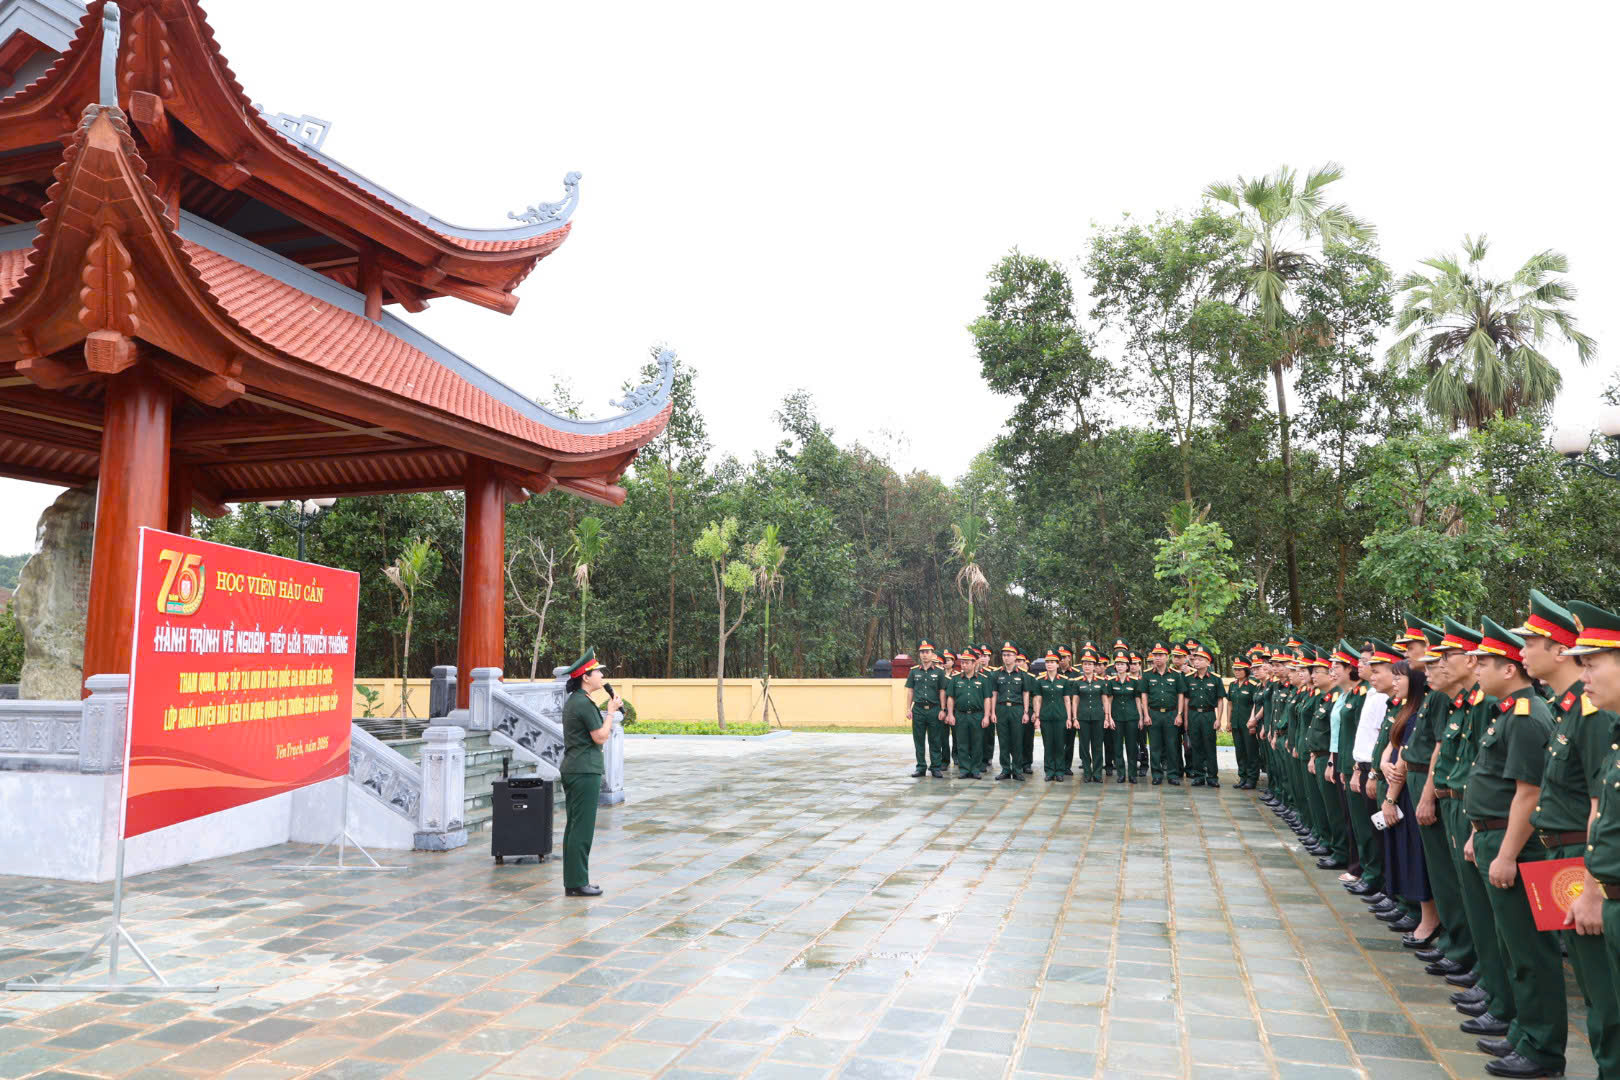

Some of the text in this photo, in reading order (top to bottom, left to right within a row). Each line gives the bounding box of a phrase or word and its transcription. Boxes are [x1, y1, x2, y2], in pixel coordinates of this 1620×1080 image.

[216, 571, 324, 604] HỌC VIỆN HẬU CẦN
[153, 620, 188, 652] HÀNH
[190, 623, 220, 655] TRÌNH
[222, 620, 235, 653] VỀ
[236, 622, 266, 653] NGUỒN
[269, 625, 287, 653] TIẾP
[287, 627, 301, 653] LỬA
[303, 628, 327, 656] TRUYỀN
[328, 629, 348, 654] THỐNG
[179, 672, 198, 693] THAM
[217, 671, 229, 695] HỌC
[230, 667, 241, 695] TẬP
[267, 666, 279, 688] TÍCH
[279, 664, 291, 689] QUỐC
[163, 705, 178, 731] LỚP
[178, 700, 197, 729] HUẤN
[197, 701, 216, 730] LUYỆN
[217, 698, 228, 724] ĐẦU
[229, 699, 242, 723] TIÊN
